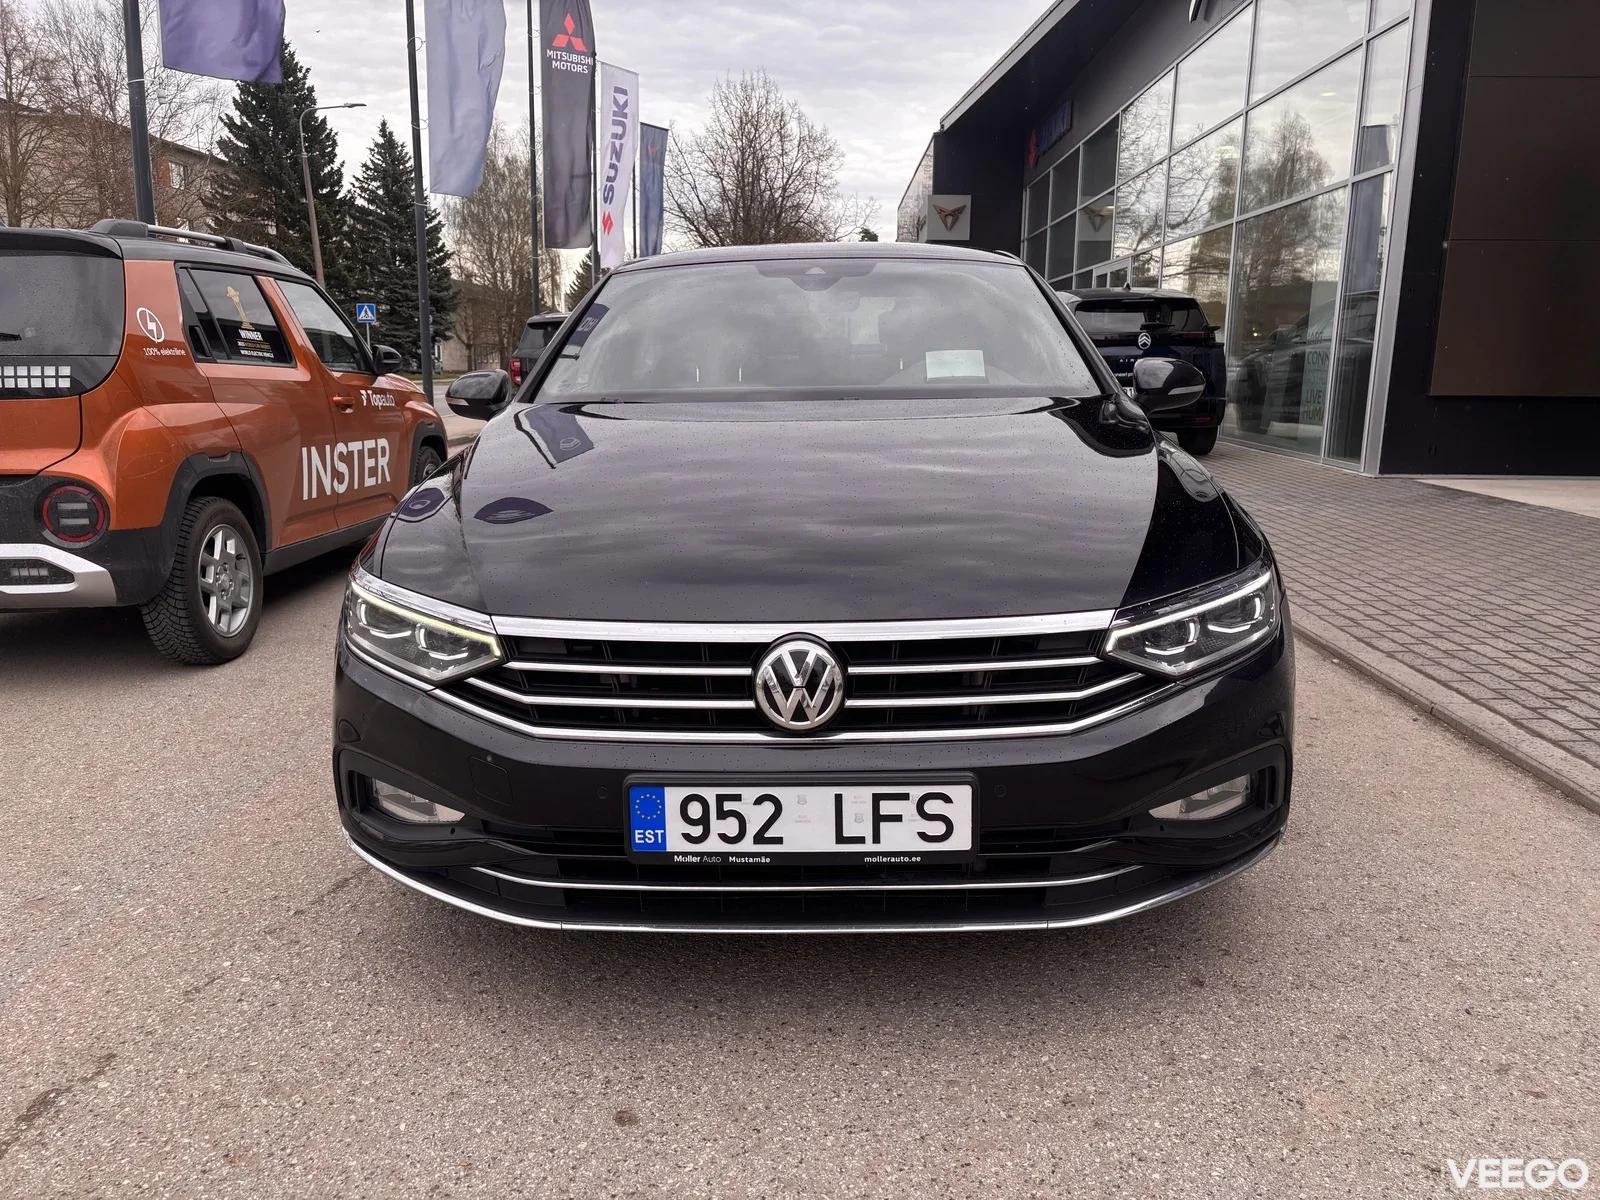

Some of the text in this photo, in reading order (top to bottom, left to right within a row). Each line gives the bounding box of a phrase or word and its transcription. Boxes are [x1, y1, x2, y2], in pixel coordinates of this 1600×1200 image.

[546, 48, 594, 66] MITSUBISHI
[552, 60, 589, 74] MOTORS
[603, 85, 629, 206] SUZUKI
[238, 329, 264, 341] WINNER
[143, 347, 161, 356] 100%
[367, 389, 395, 410] Topauto
[301, 437, 392, 501] INSTER
[679, 791, 955, 845] 952 LFS
[634, 829, 664, 844] EST
[674, 854, 771, 863] Moller Auto Mustamäe
[864, 854, 922, 863] mollerauto.ee
